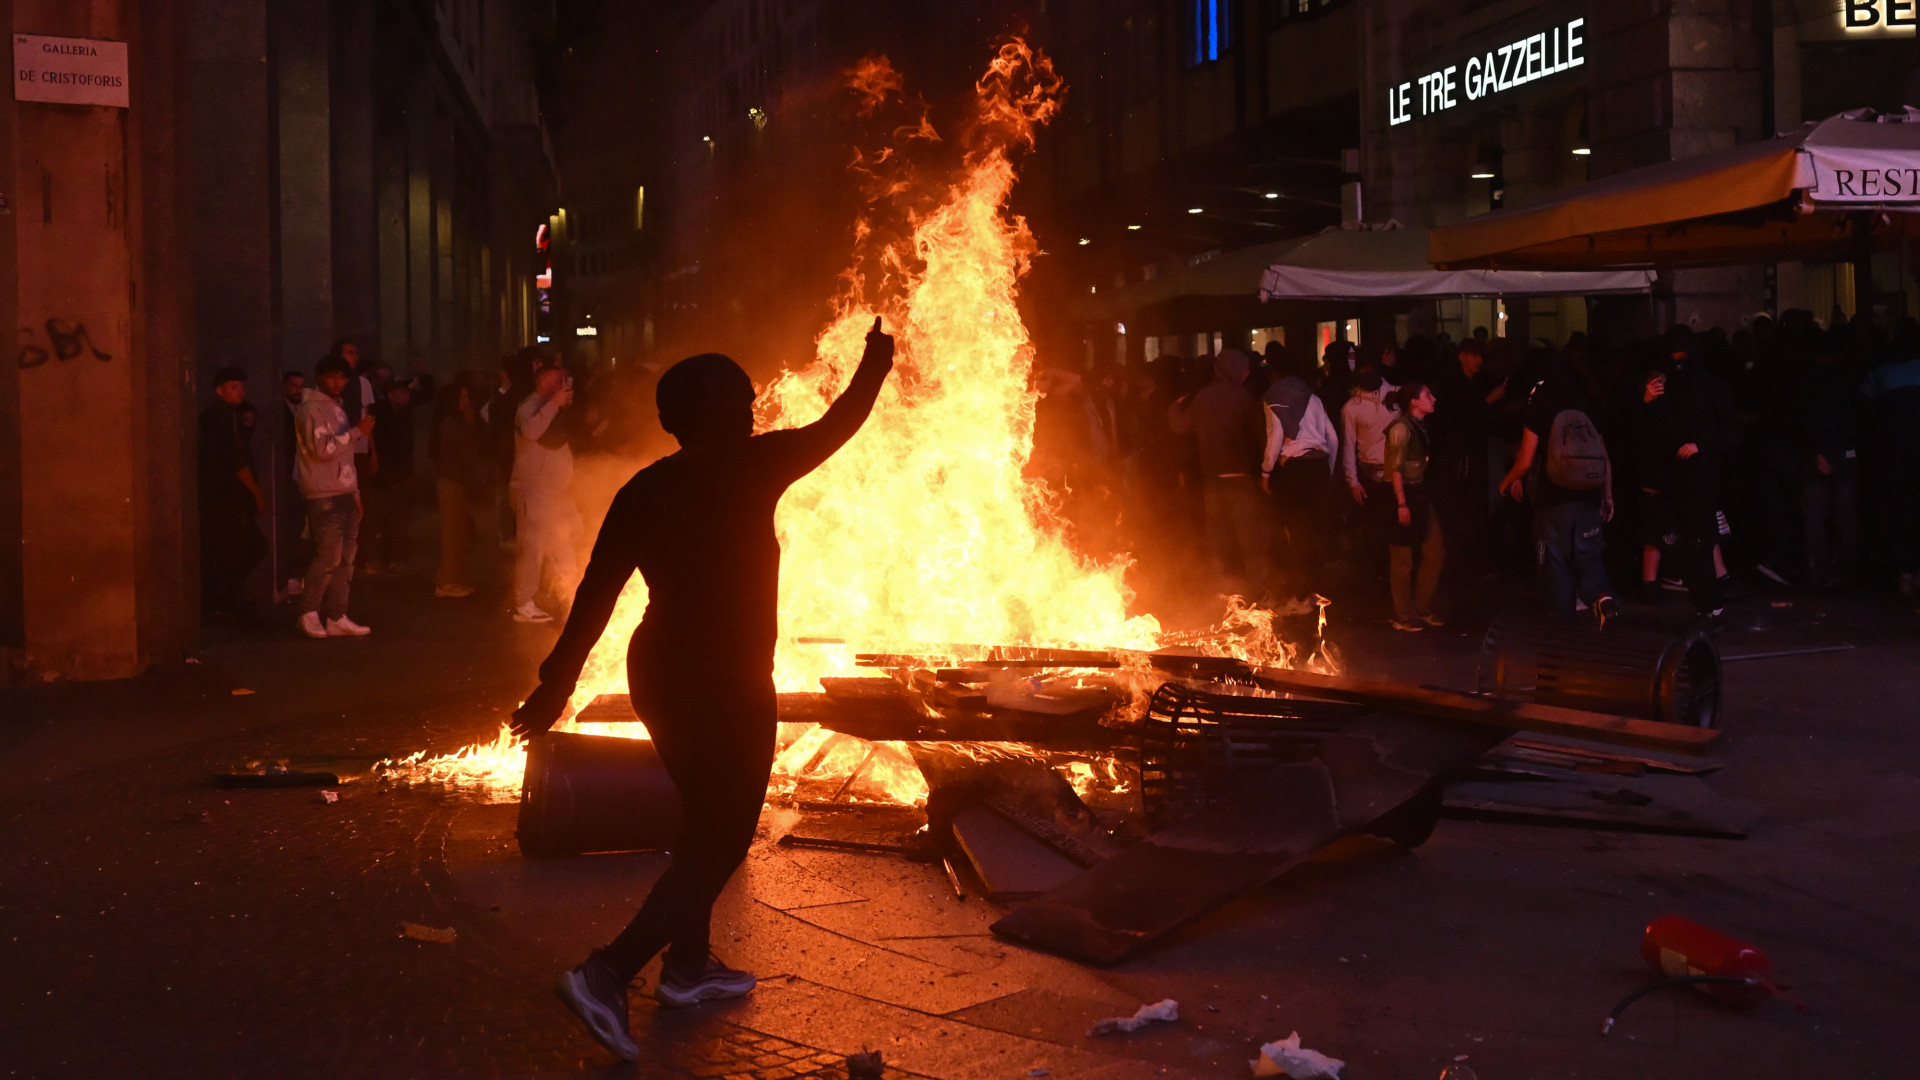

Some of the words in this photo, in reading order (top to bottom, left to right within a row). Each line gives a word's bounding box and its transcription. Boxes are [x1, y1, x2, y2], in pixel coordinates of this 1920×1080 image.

[42, 43, 98, 57] GALLERIA
[20, 70, 35, 82] DE
[41, 71, 122, 88] CRISTOFORIS
[1389, 81, 1412, 126] LE
[1418, 65, 1457, 116] TRE
[1465, 17, 1585, 101] GAZZELLE
[1833, 168, 1920, 196] REST
